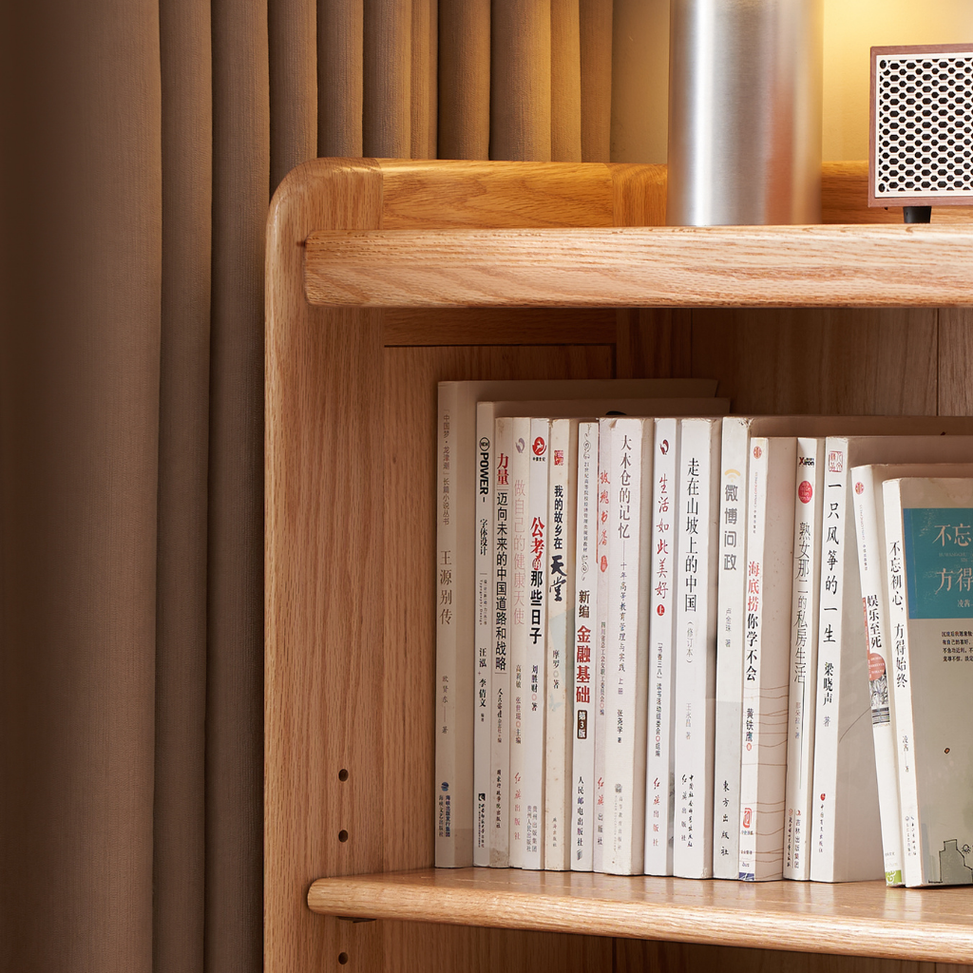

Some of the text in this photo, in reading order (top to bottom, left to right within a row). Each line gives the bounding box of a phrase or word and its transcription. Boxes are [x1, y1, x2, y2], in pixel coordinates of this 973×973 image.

[479, 452, 489, 495] POWER
[496, 453, 510, 486] 力量
[618, 434, 632, 540] 大木仓的记忆
[479, 518, 488, 556] 字体设计
[513, 480, 526, 626] 做自己的健康天使
[549, 484, 567, 602] 我的故乡在 天堂
[655, 473, 670, 600] 生活如此美好
[684, 457, 700, 613] 走在山坡上的中国
[723, 483, 739, 572] 微博问政
[822, 483, 842, 645] 一只风筝的一生
[439, 550, 453, 626] 王源别传
[495, 493, 508, 671] 迈向未来的中国道路和战略
[578, 589, 590, 619] 新编
[746, 561, 760, 682] 海底捞你学不会
[867, 595, 883, 649] 娱乐至死
[576, 625, 591, 704] 金融基础
[823, 661, 834, 706] 梁晓声
[576, 776, 585, 847] 人民邮电出版社
